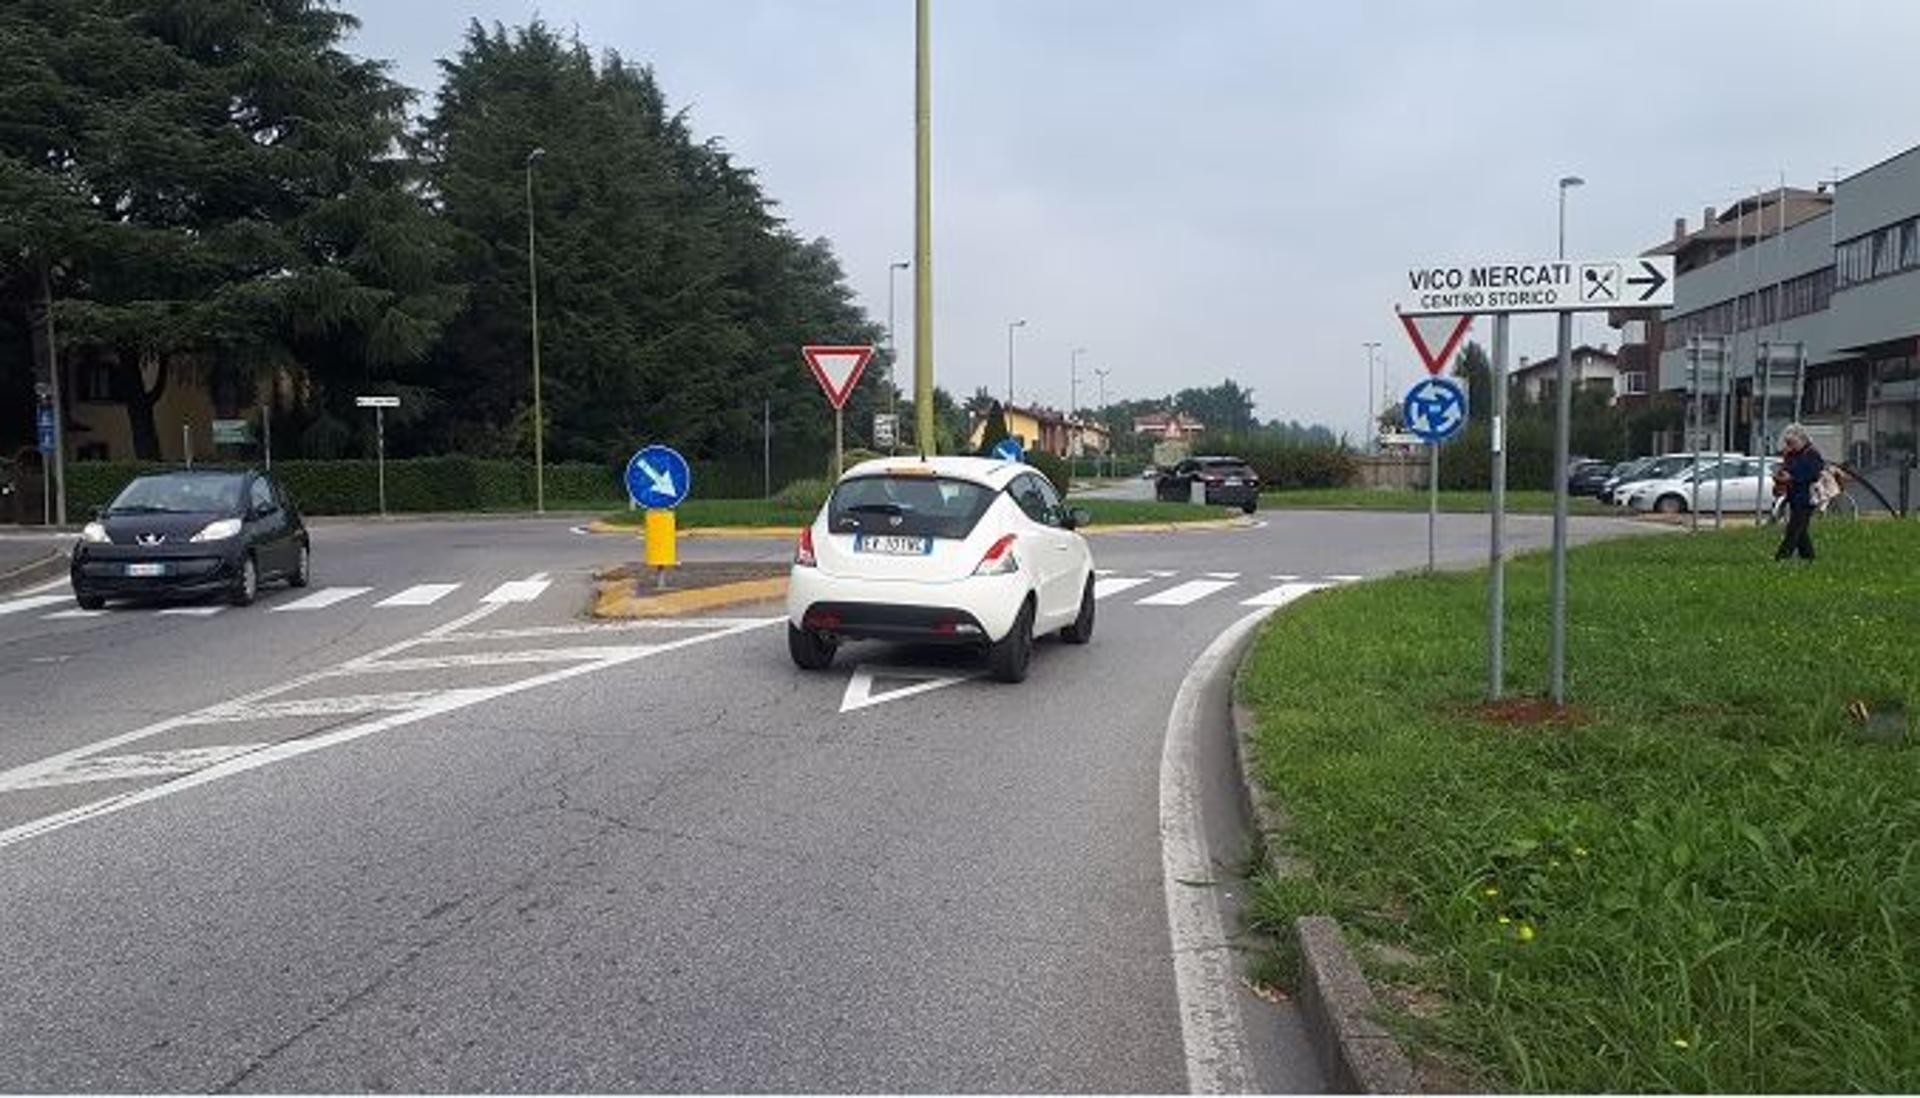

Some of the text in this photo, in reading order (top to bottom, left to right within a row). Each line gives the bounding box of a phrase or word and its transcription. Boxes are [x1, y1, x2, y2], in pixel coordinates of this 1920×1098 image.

[1409, 265, 1571, 290] VICO MERCATI
[1420, 290, 1557, 309] CENTRO STORICO
